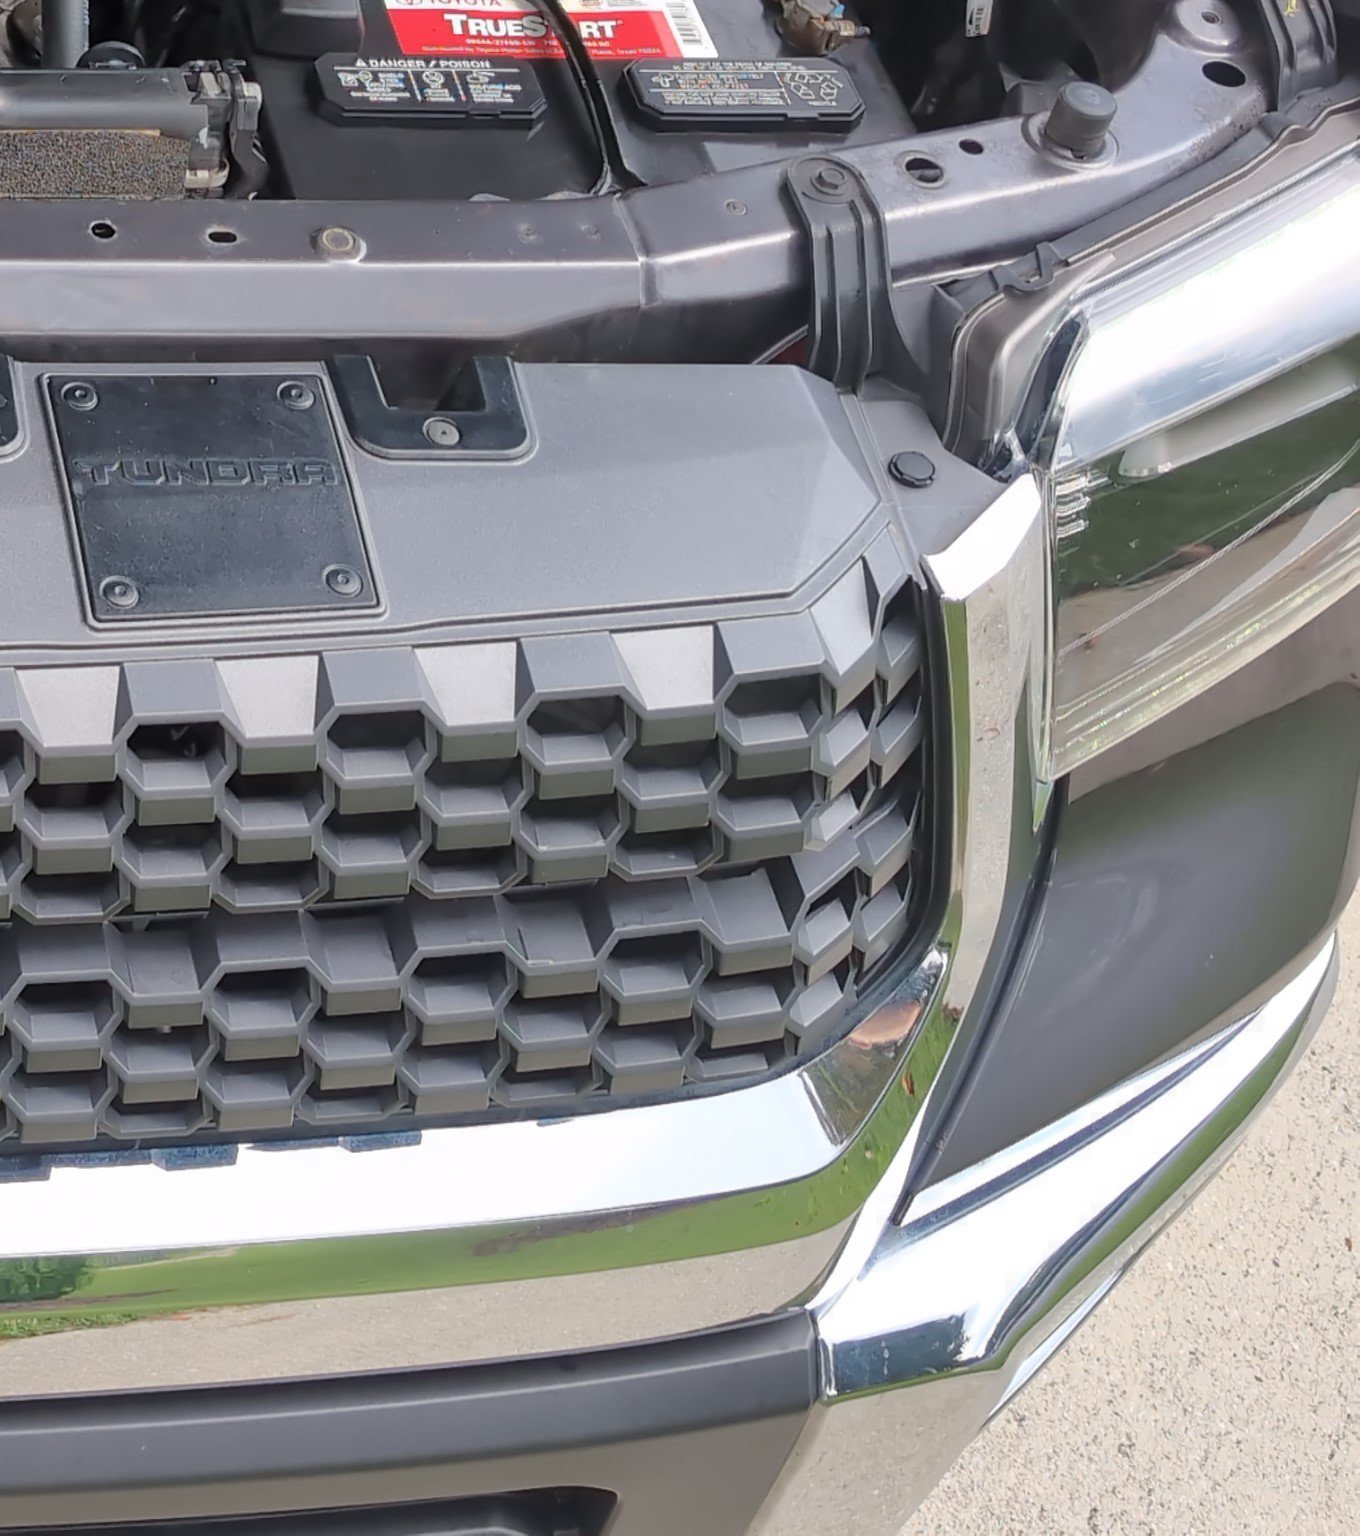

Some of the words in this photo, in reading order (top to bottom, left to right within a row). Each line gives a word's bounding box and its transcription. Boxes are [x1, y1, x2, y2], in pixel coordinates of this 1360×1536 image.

[443, 13, 616, 38] TRUESRT
[369, 58, 426, 68] DANGER
[439, 59, 491, 69] POISON
[74, 458, 339, 486] TUNDRA
